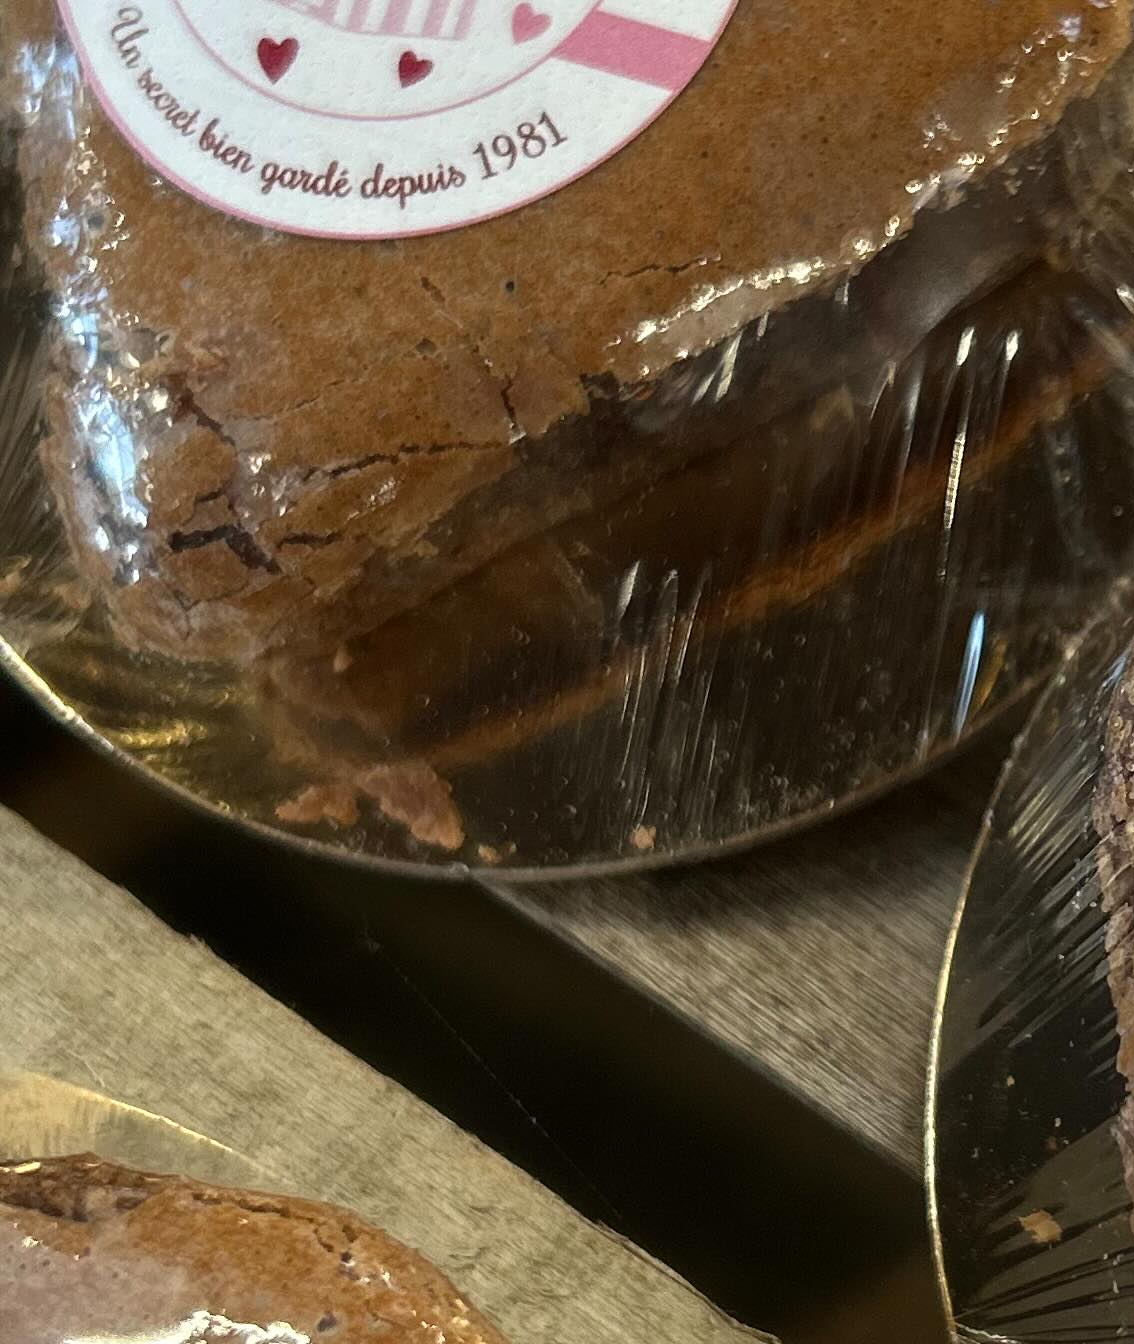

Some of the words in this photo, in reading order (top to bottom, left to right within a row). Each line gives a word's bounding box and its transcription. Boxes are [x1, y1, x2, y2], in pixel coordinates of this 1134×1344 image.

[110, 7, 145, 72] Un
[139, 68, 201, 136] secret
[199, 124, 255, 175] bien
[260, 160, 352, 198] gardé
[360, 166, 468, 210] depuis
[473, 110, 568, 181] 1981
